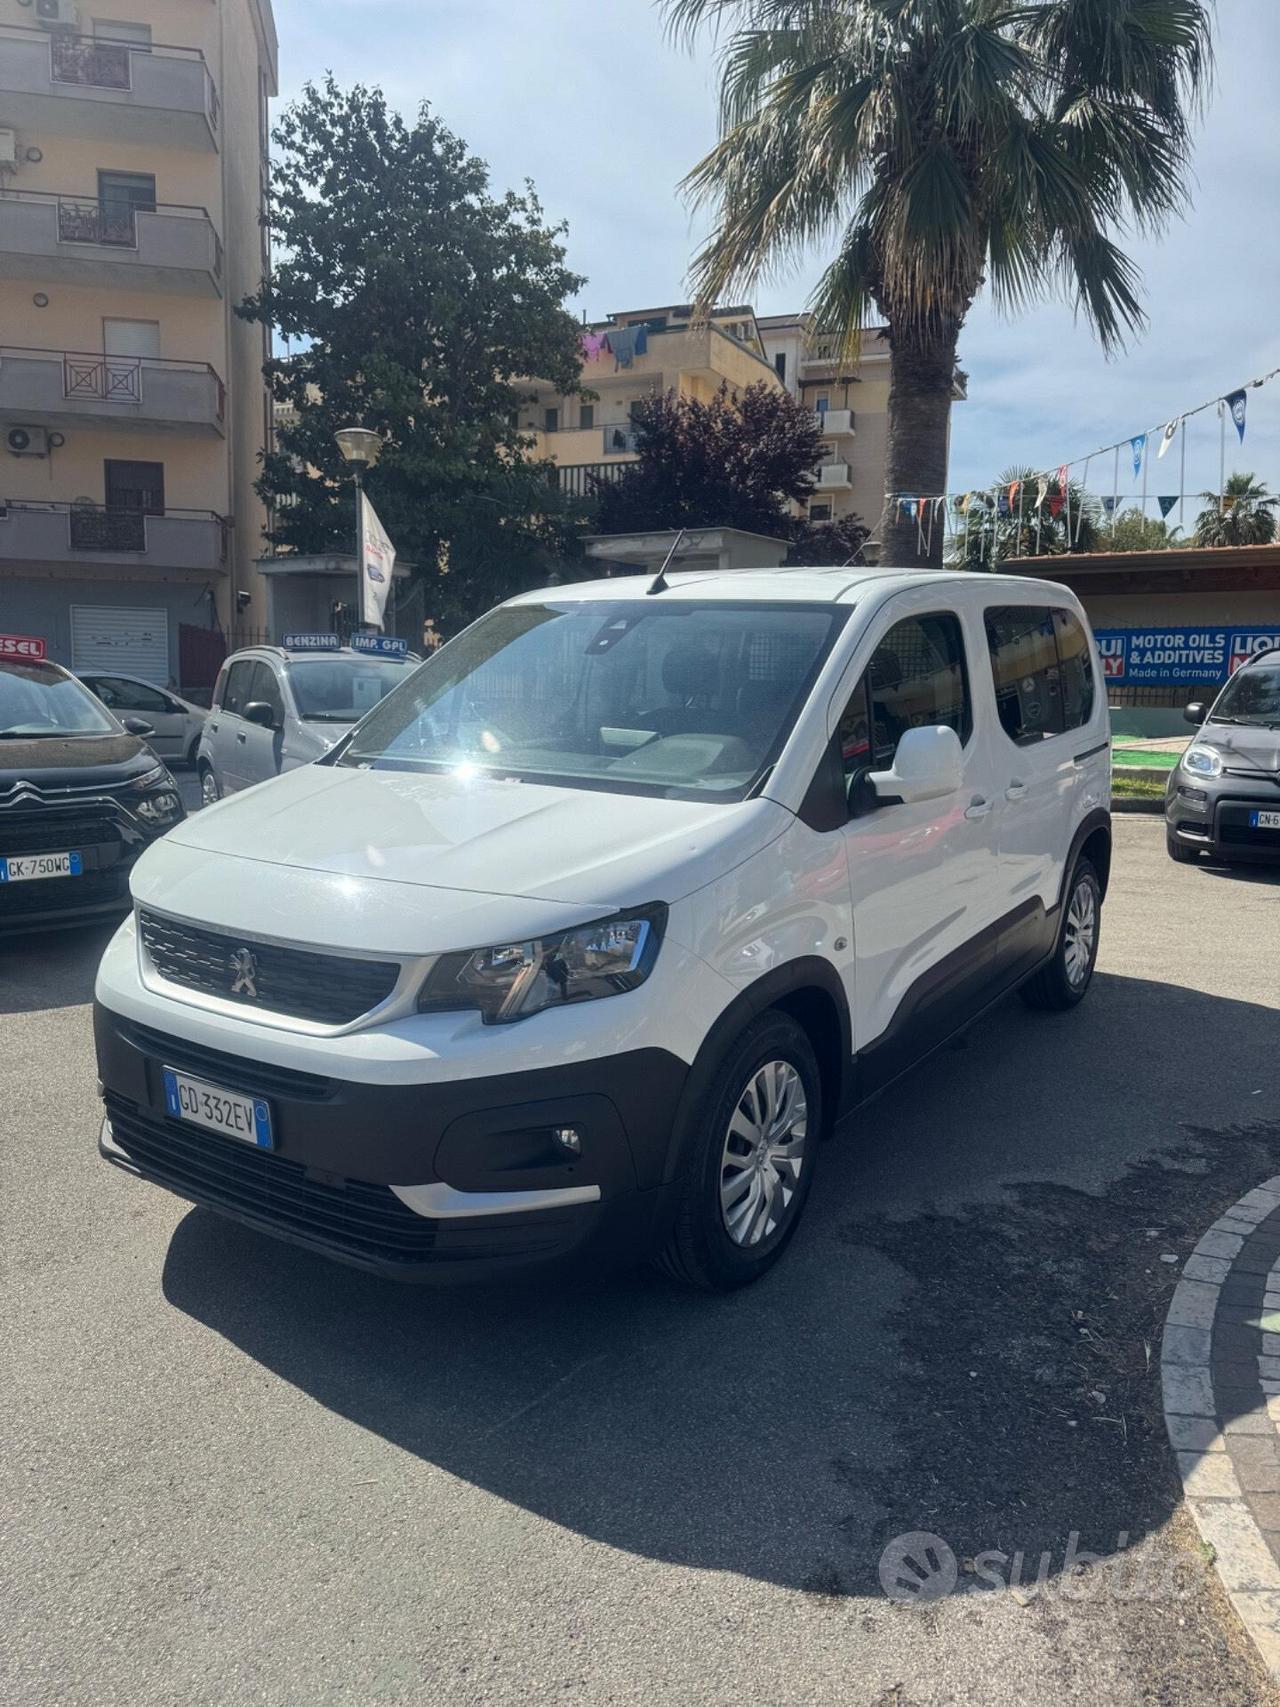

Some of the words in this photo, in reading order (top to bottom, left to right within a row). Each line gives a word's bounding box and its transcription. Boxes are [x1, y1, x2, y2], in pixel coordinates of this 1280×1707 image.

[285, 636, 338, 647] BENZINA
[355, 637, 379, 649] IMP.
[382, 640, 404, 651] GPL
[1131, 635, 1185, 648] MOTOR
[1189, 634, 1225, 648] OILS
[1129, 650, 1141, 665] &
[1143, 649, 1224, 664] ADDITIVES
[1129, 668, 1157, 678] Made
[1160, 667, 1170, 677] in
[1172, 667, 1222, 680] Germany
